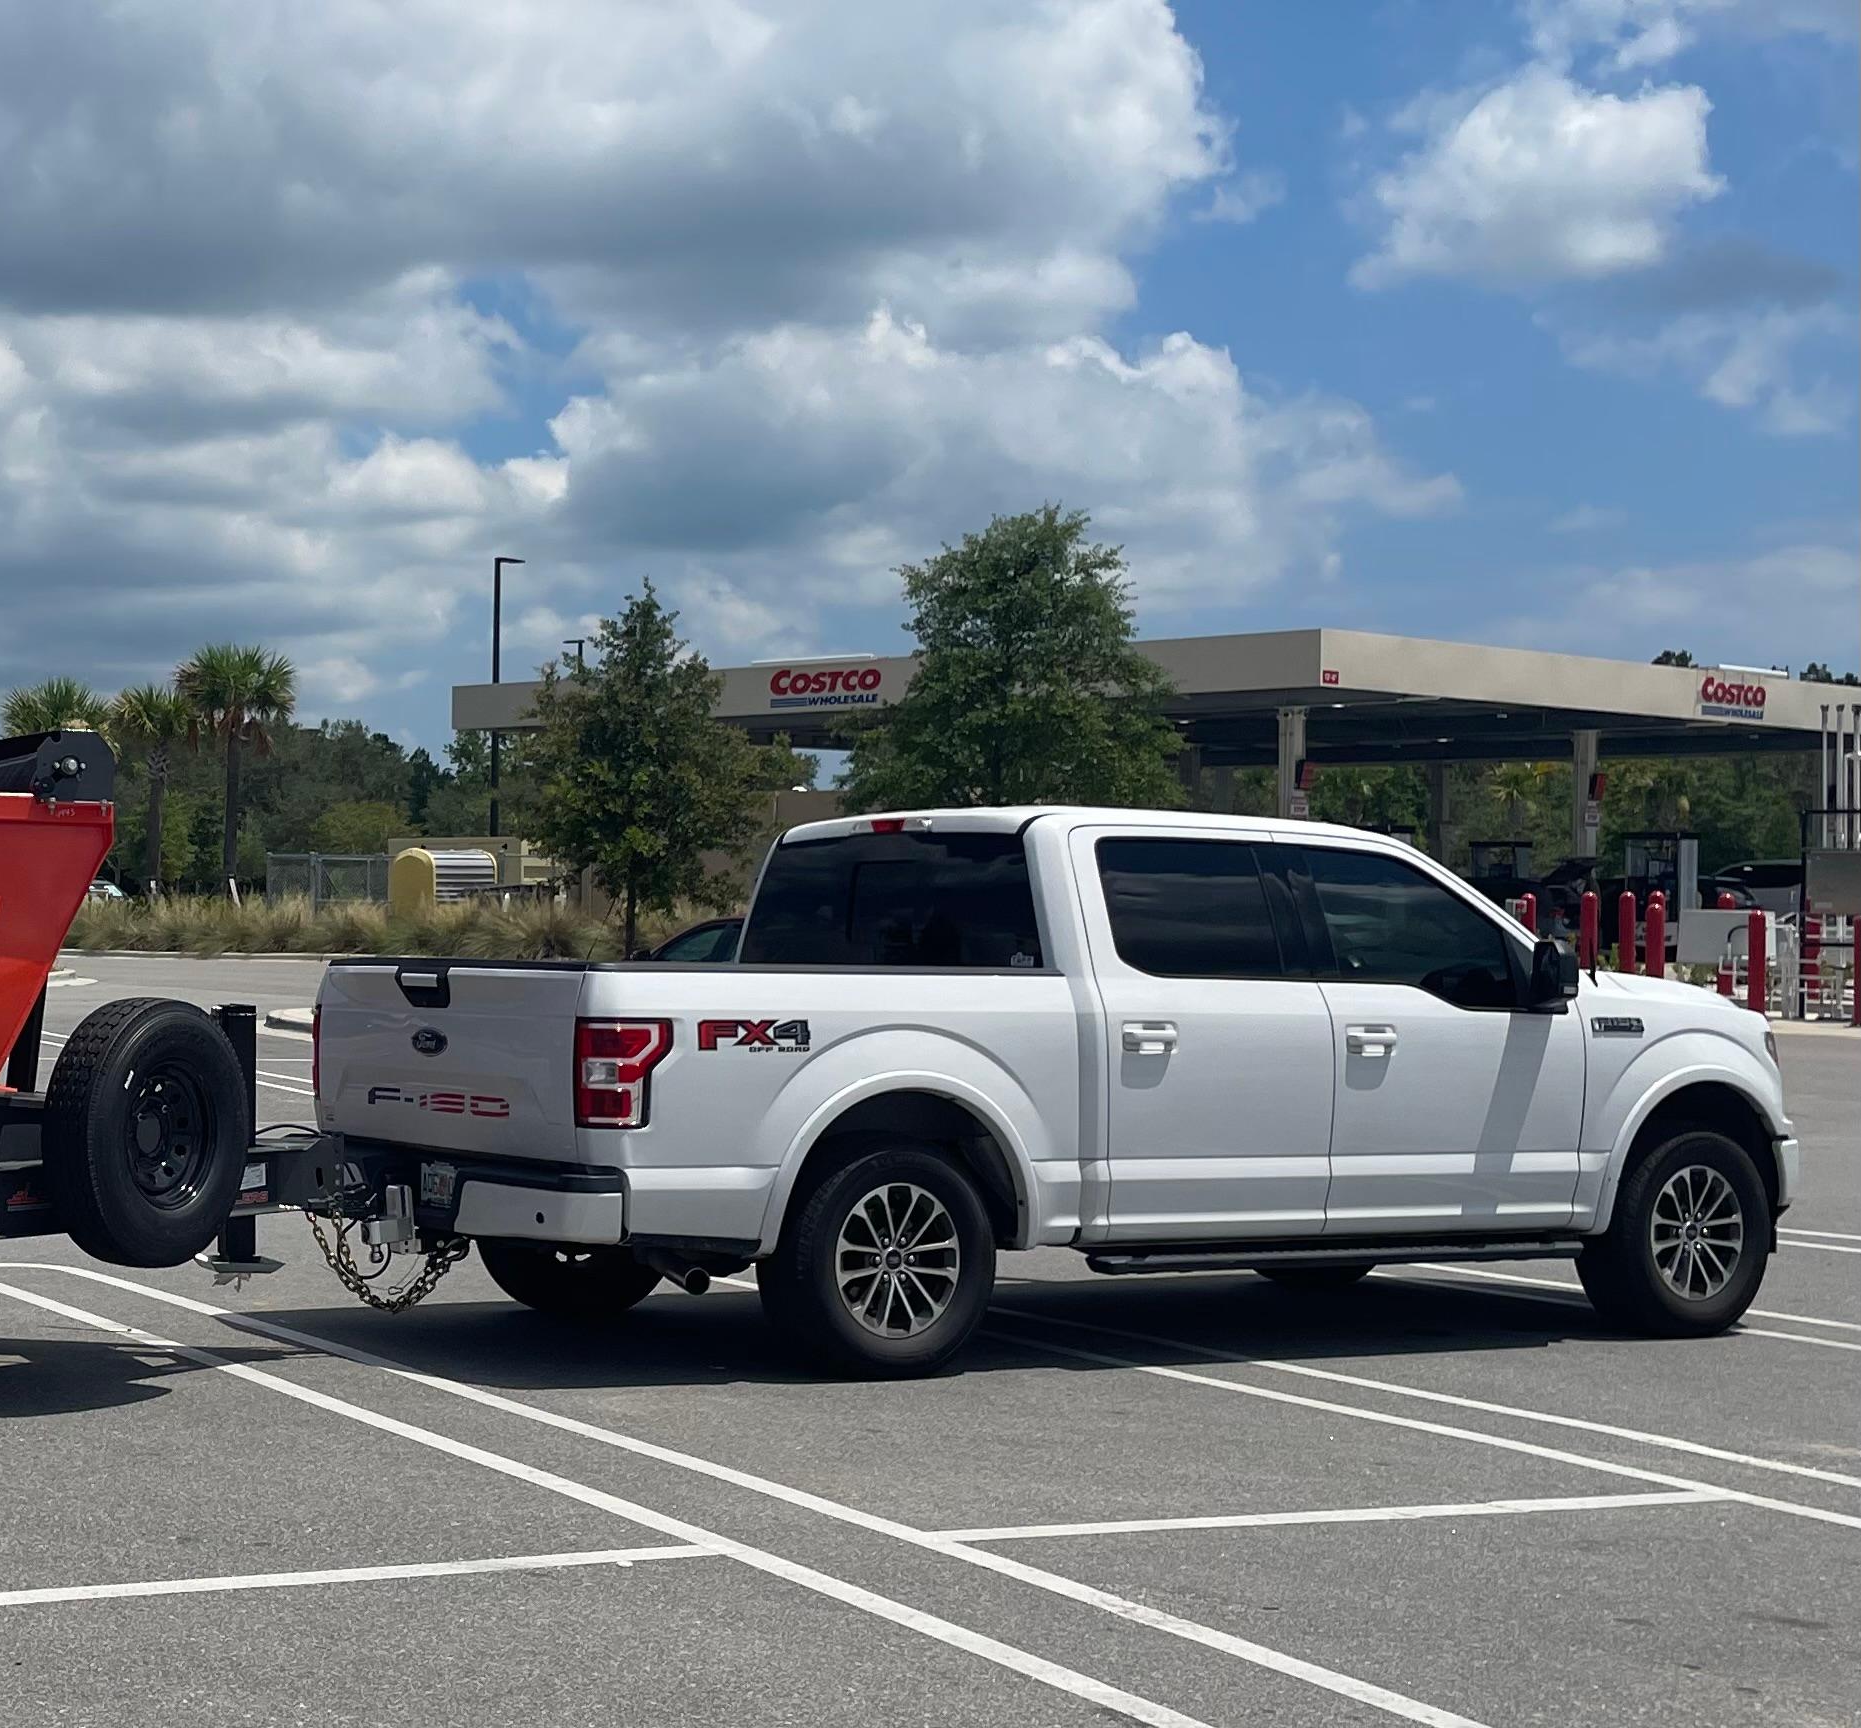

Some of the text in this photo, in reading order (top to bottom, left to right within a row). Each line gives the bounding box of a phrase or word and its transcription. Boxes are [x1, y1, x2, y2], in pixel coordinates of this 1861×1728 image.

[770, 669, 881, 696] COSTCO
[1702, 677, 1766, 707] COSTCO
[807, 694, 878, 706] WHOLESALE
[697, 1019, 811, 1051] FX4
